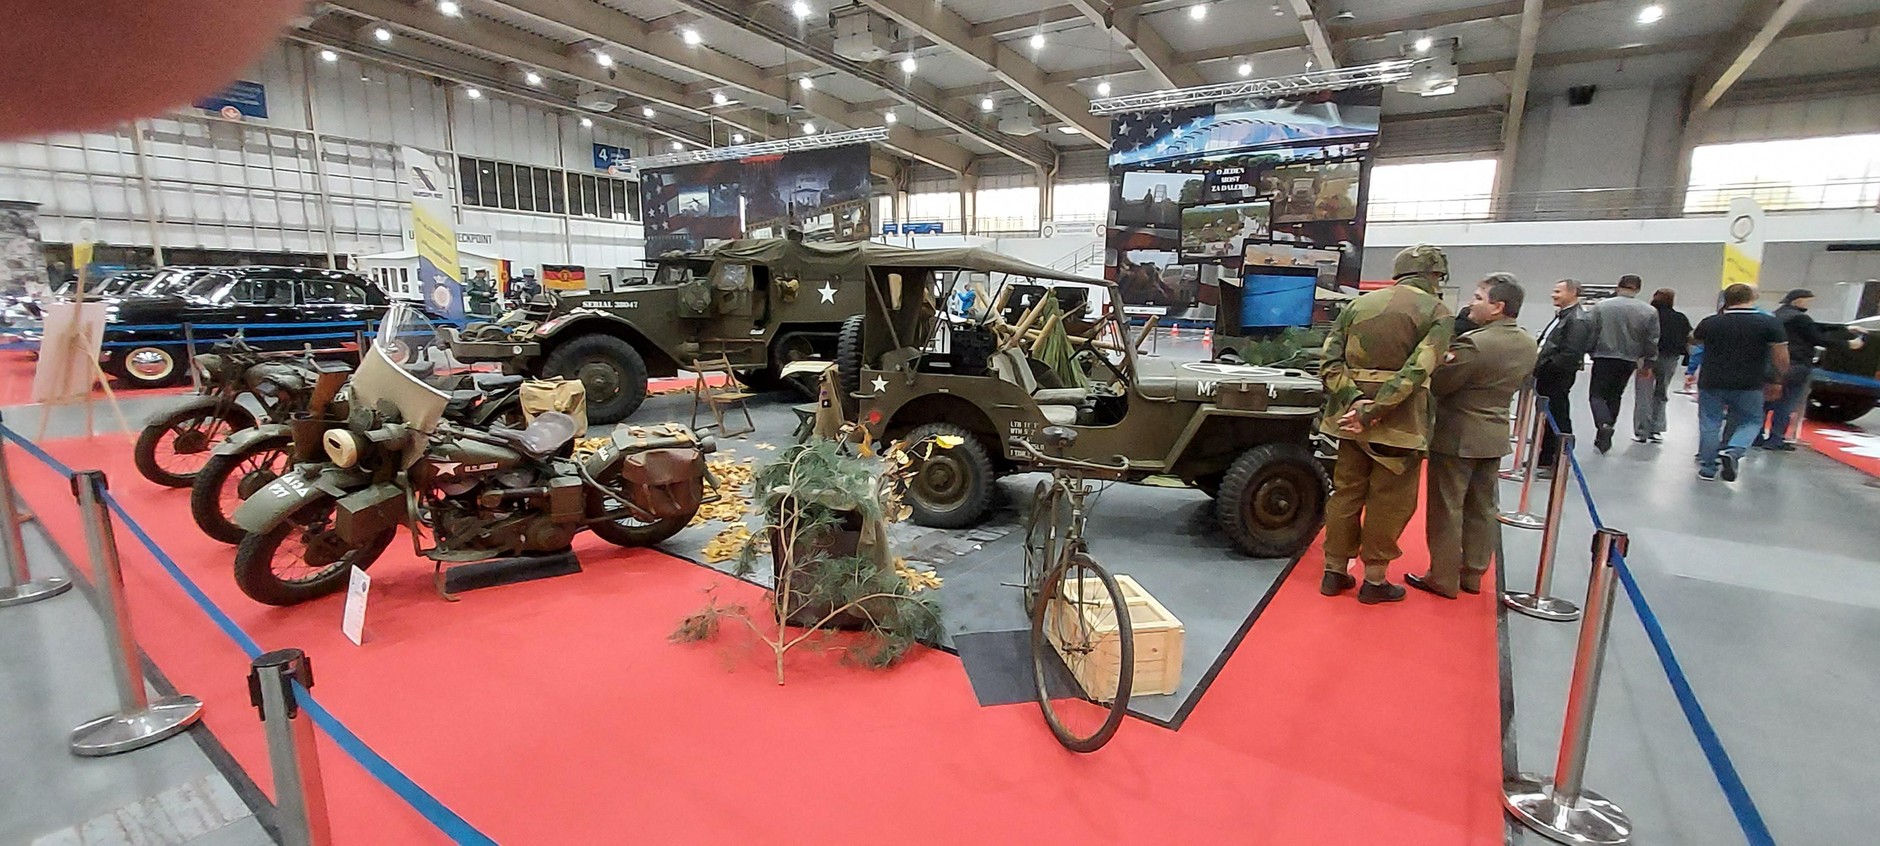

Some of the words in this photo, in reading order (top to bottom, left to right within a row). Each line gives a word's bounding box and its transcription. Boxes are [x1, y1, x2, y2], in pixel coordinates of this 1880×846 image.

[599, 148, 608, 161] 4
[1223, 167, 1245, 175] JEDEN
[1221, 175, 1241, 183] MOST
[1211, 184, 1220, 192] ZA
[456, 232, 492, 244] ECKPOINT
